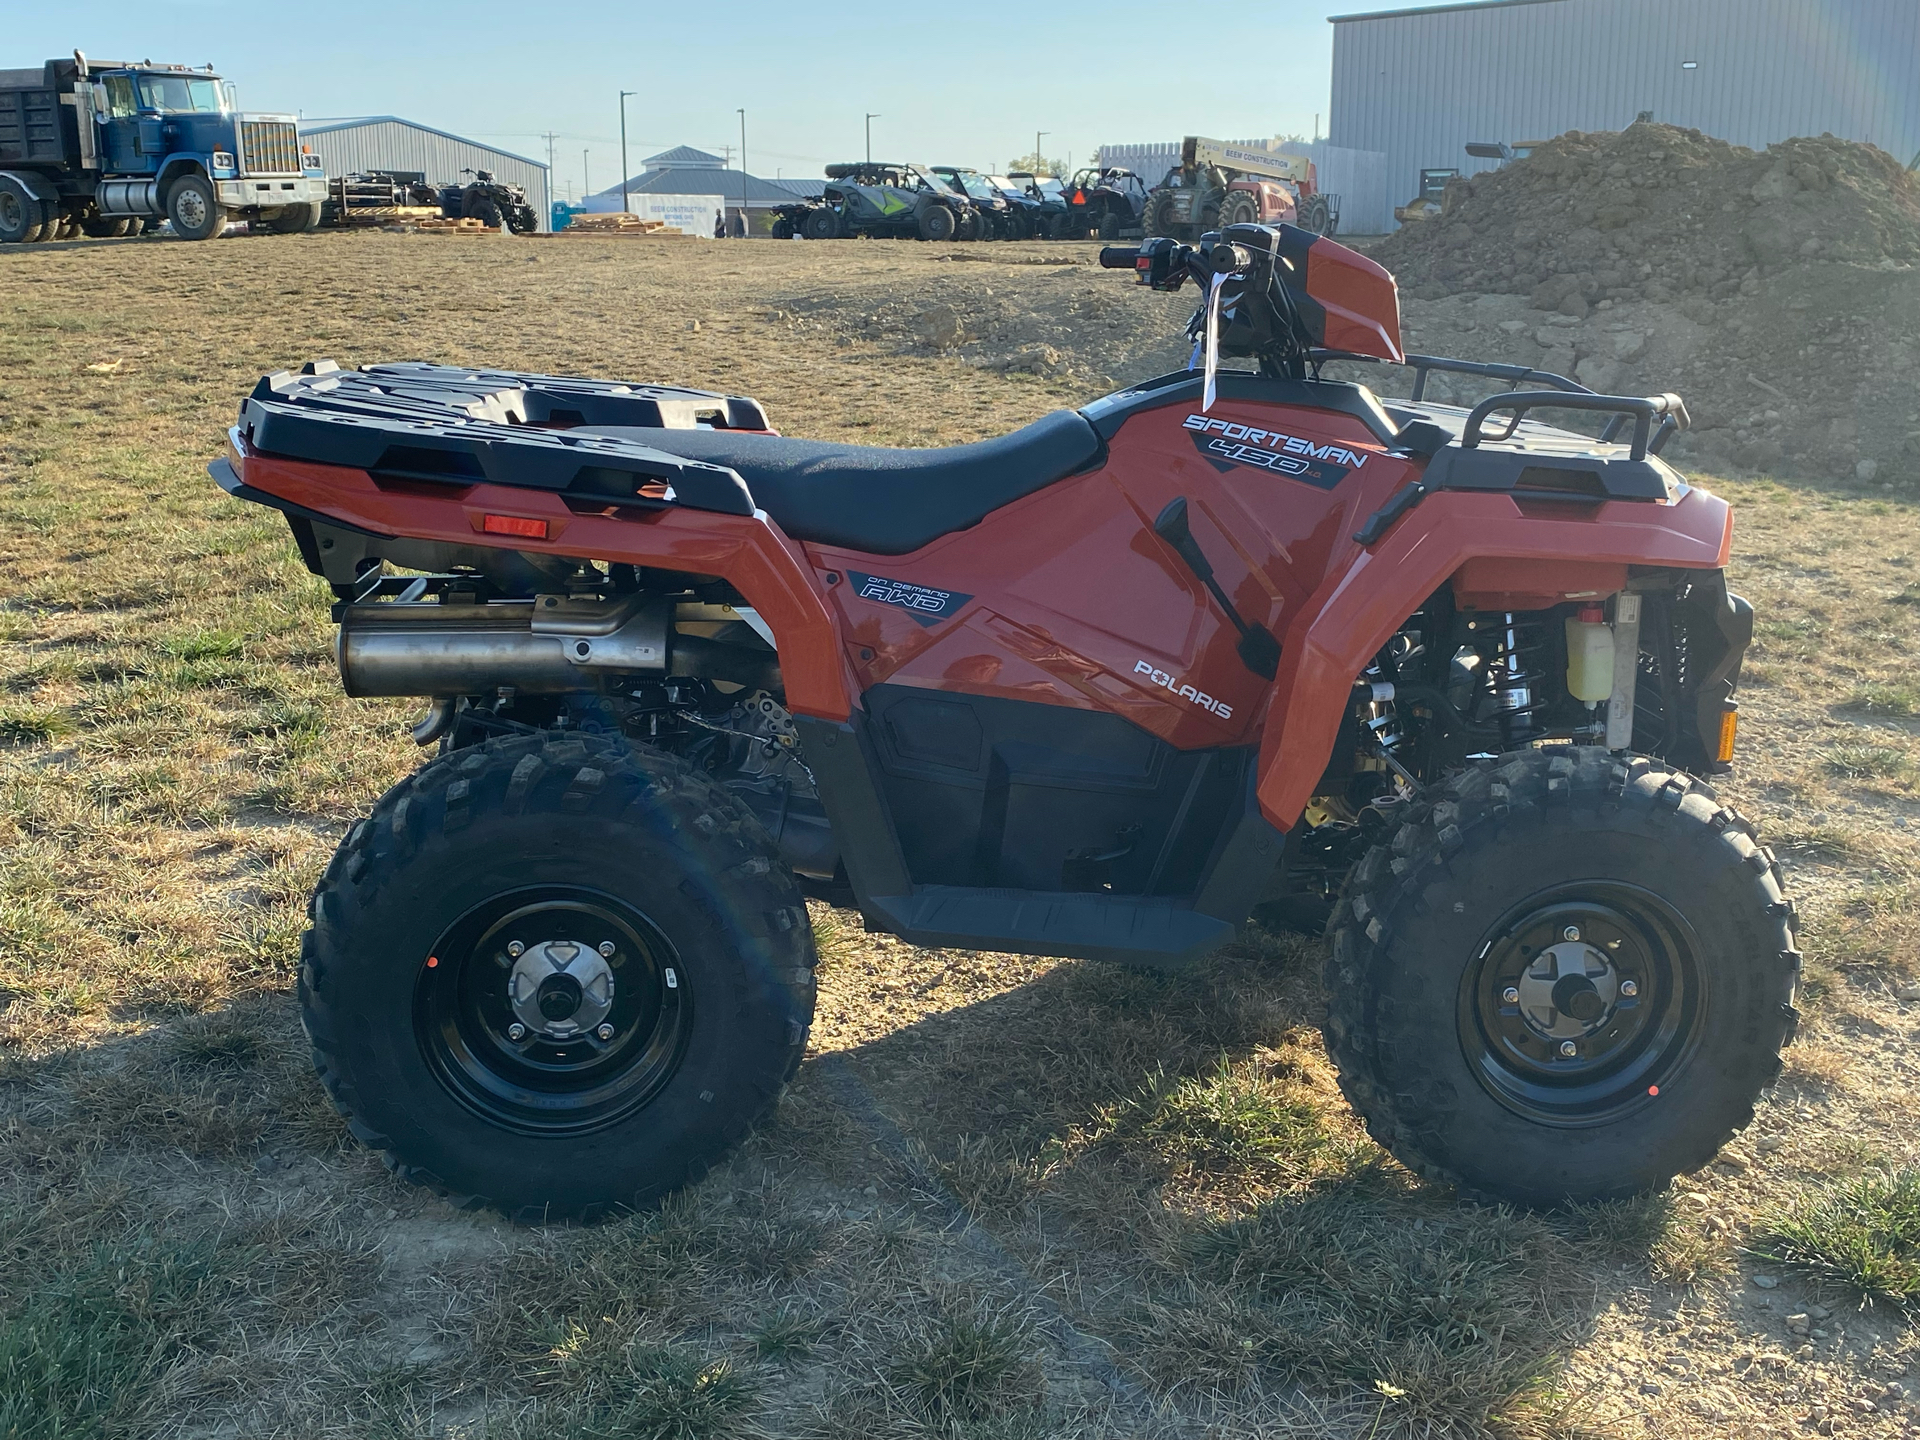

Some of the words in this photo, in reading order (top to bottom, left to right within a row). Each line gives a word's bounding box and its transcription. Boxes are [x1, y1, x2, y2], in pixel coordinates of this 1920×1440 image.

[1225, 149, 1243, 159] BEEM
[1243, 153, 1289, 169] CONSTRUCTION
[1182, 413, 1369, 469] SPORTSMAN
[1208, 438, 1310, 476] 450
[860, 583, 946, 612] AWD
[867, 576, 888, 585] ON
[892, 582, 950, 599] DEMAND
[1133, 659, 1234, 720] POLARIS
